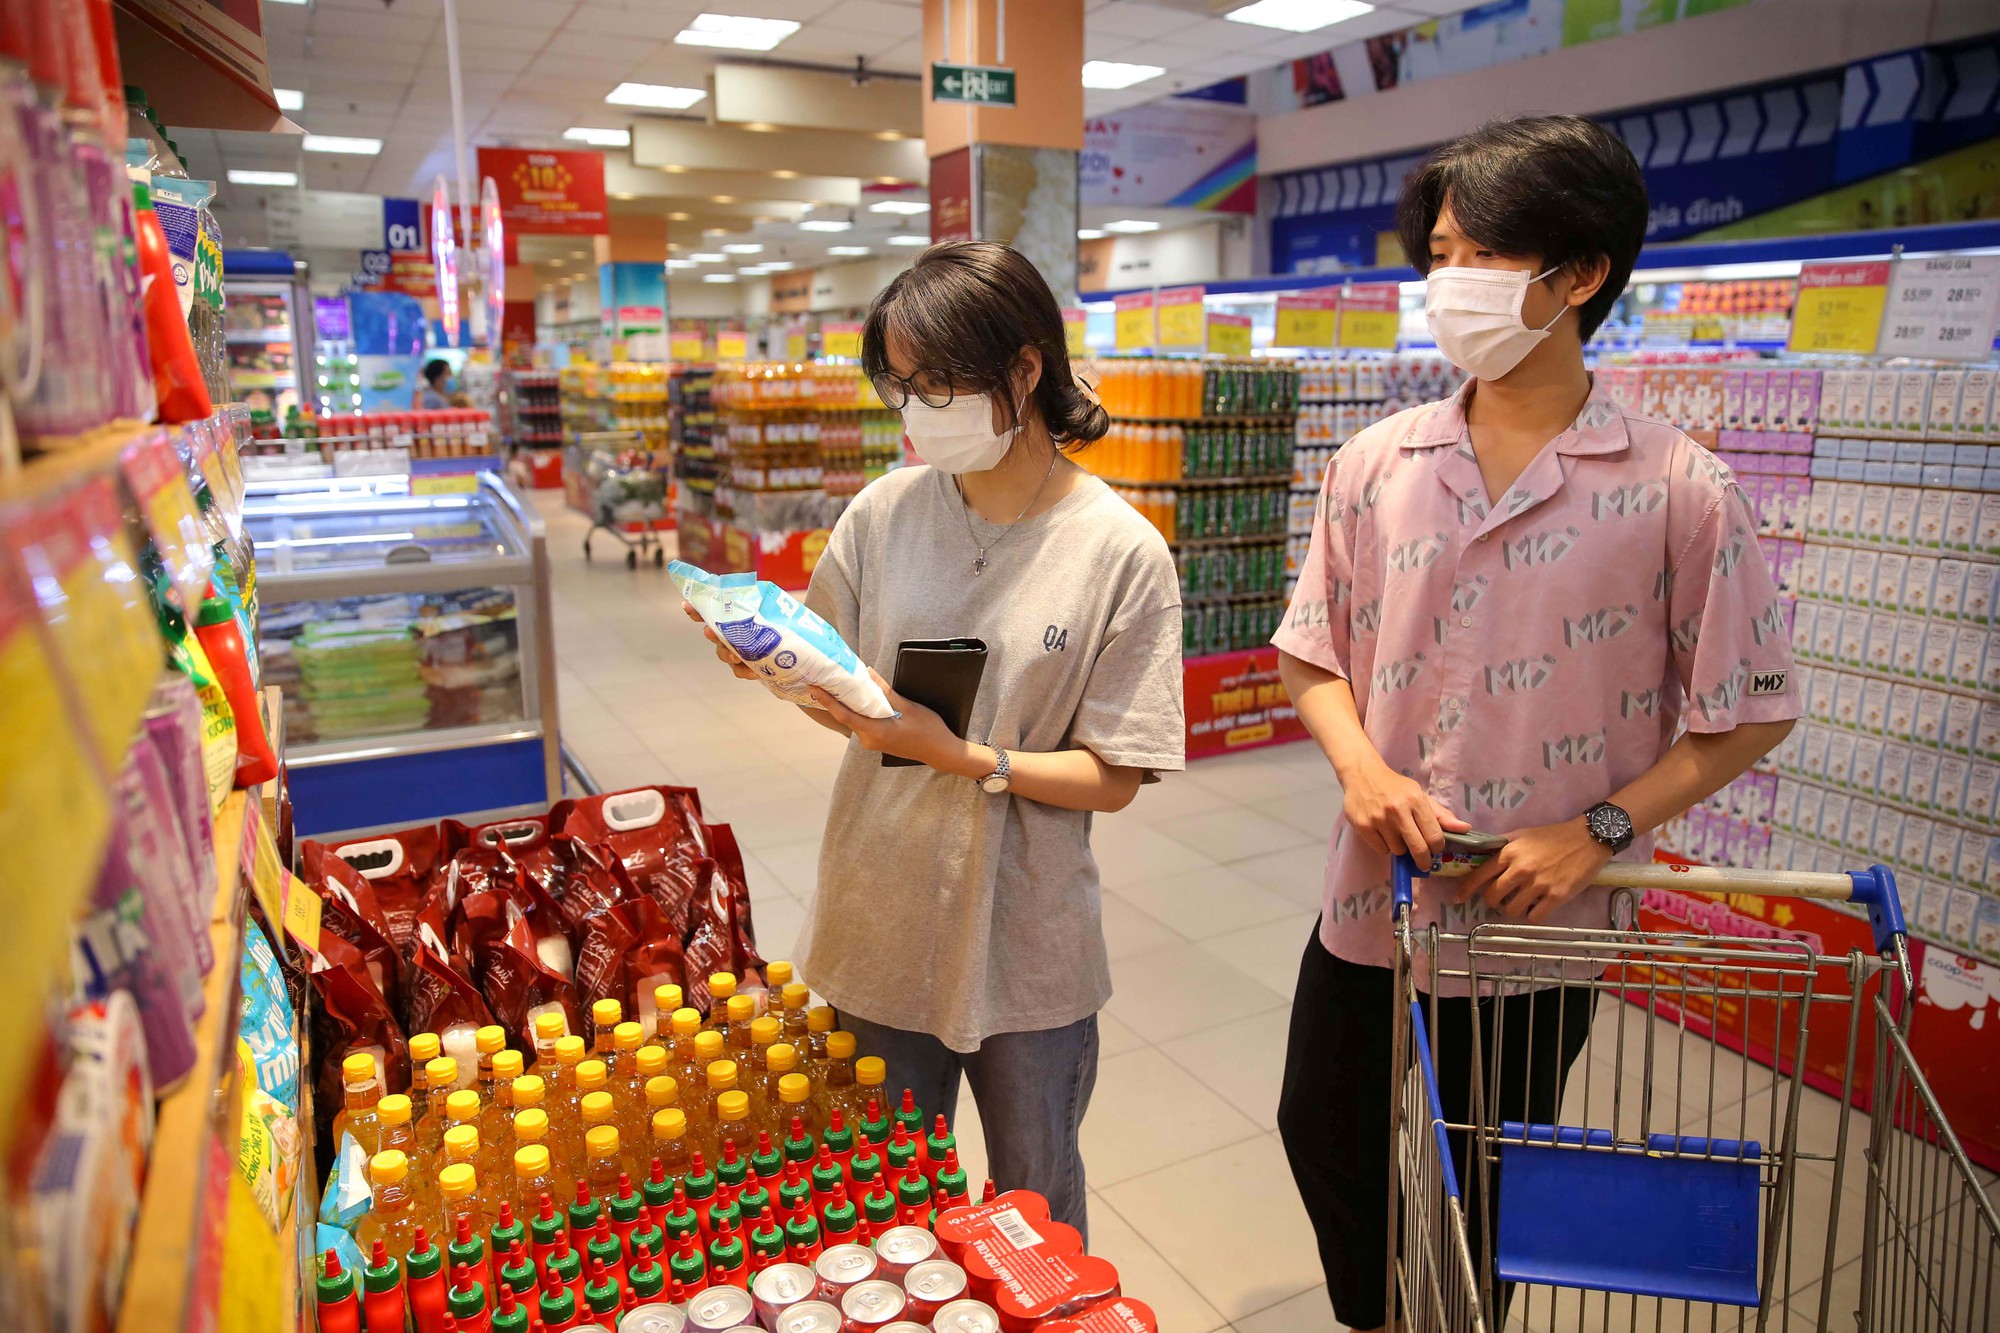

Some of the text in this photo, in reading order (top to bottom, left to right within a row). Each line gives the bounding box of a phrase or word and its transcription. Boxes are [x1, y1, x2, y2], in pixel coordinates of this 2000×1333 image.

[989, 80, 1008, 94] EXIT
[388, 224, 417, 249] 01
[1043, 625, 1067, 652] QA
[947, 1201, 1014, 1225] TÁI CHẾ TÔI
